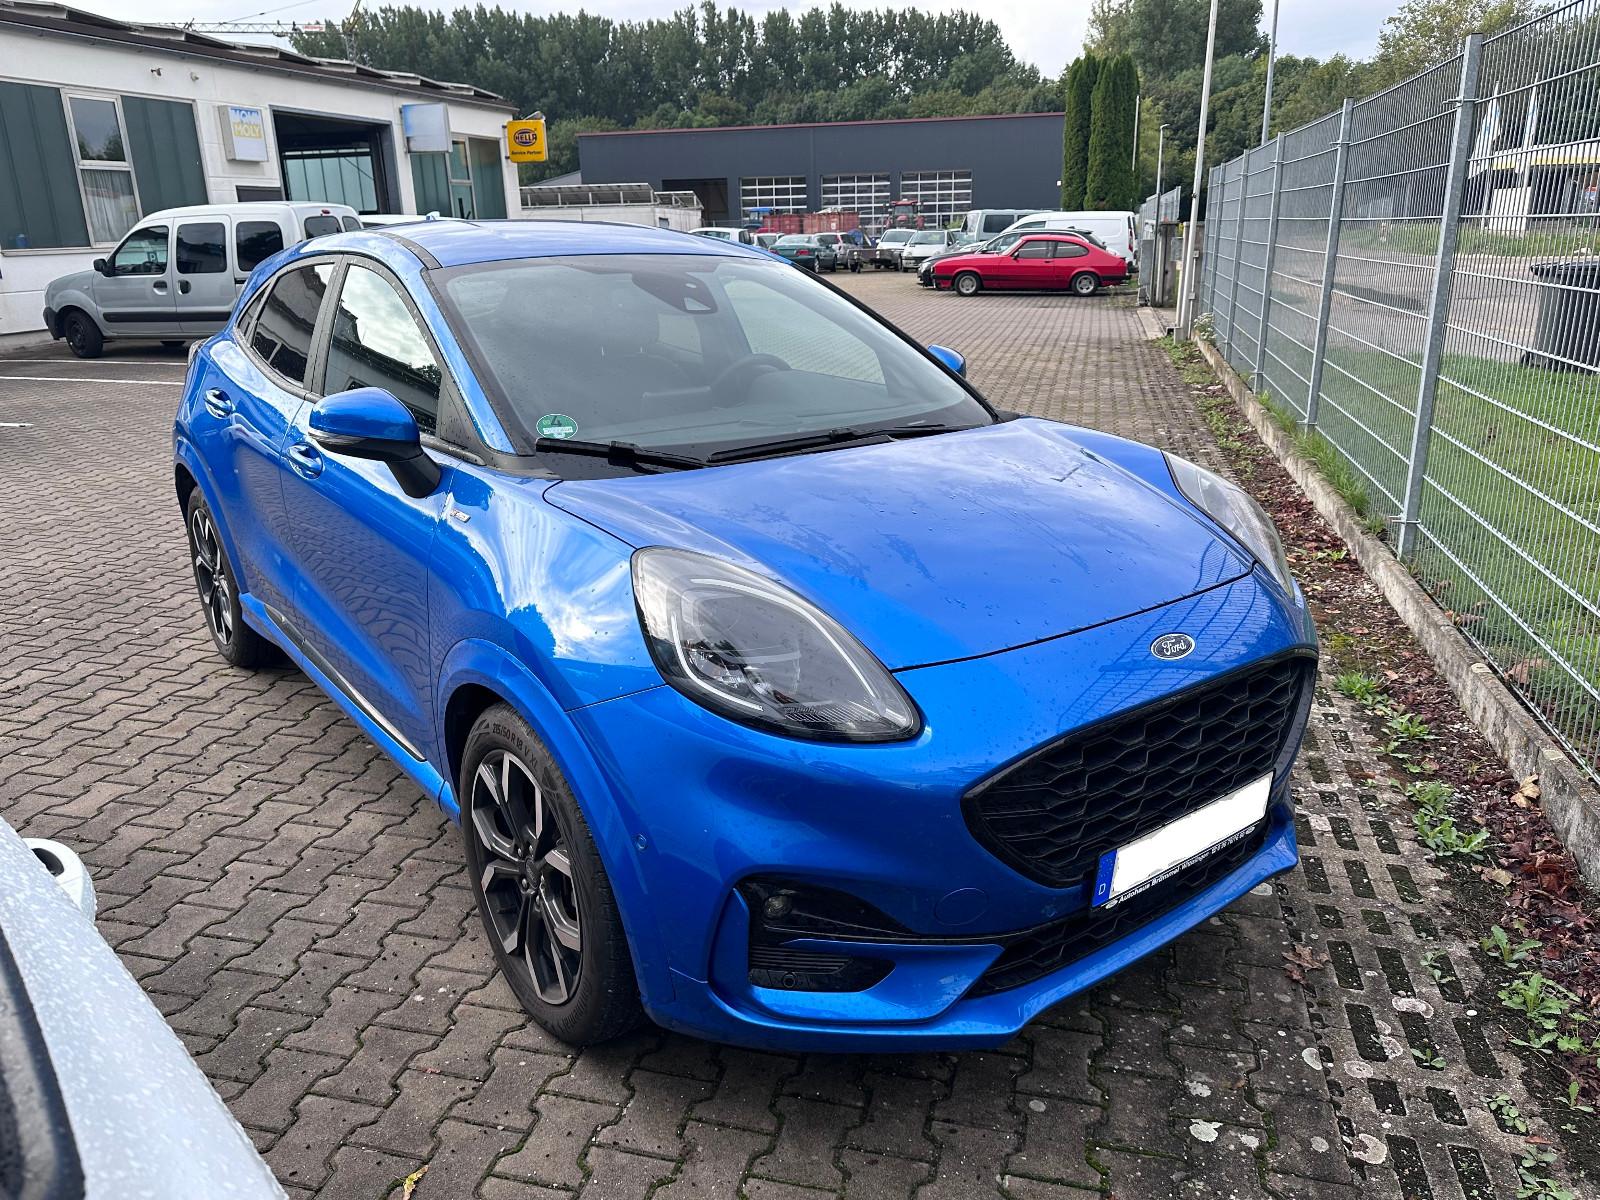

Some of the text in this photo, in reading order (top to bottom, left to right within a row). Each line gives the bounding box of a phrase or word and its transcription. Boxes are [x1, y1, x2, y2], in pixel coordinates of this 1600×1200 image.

[232, 122, 261, 137] MOLY
[514, 132, 537, 142] HELLA
[550, 415, 562, 427] 4
[1161, 638, 1187, 656] Ford
[492, 722, 511, 740] 215/50
[516, 737, 524, 750] 18
[1098, 883, 1106, 896] D
[1118, 884, 1151, 904] Autohaus
